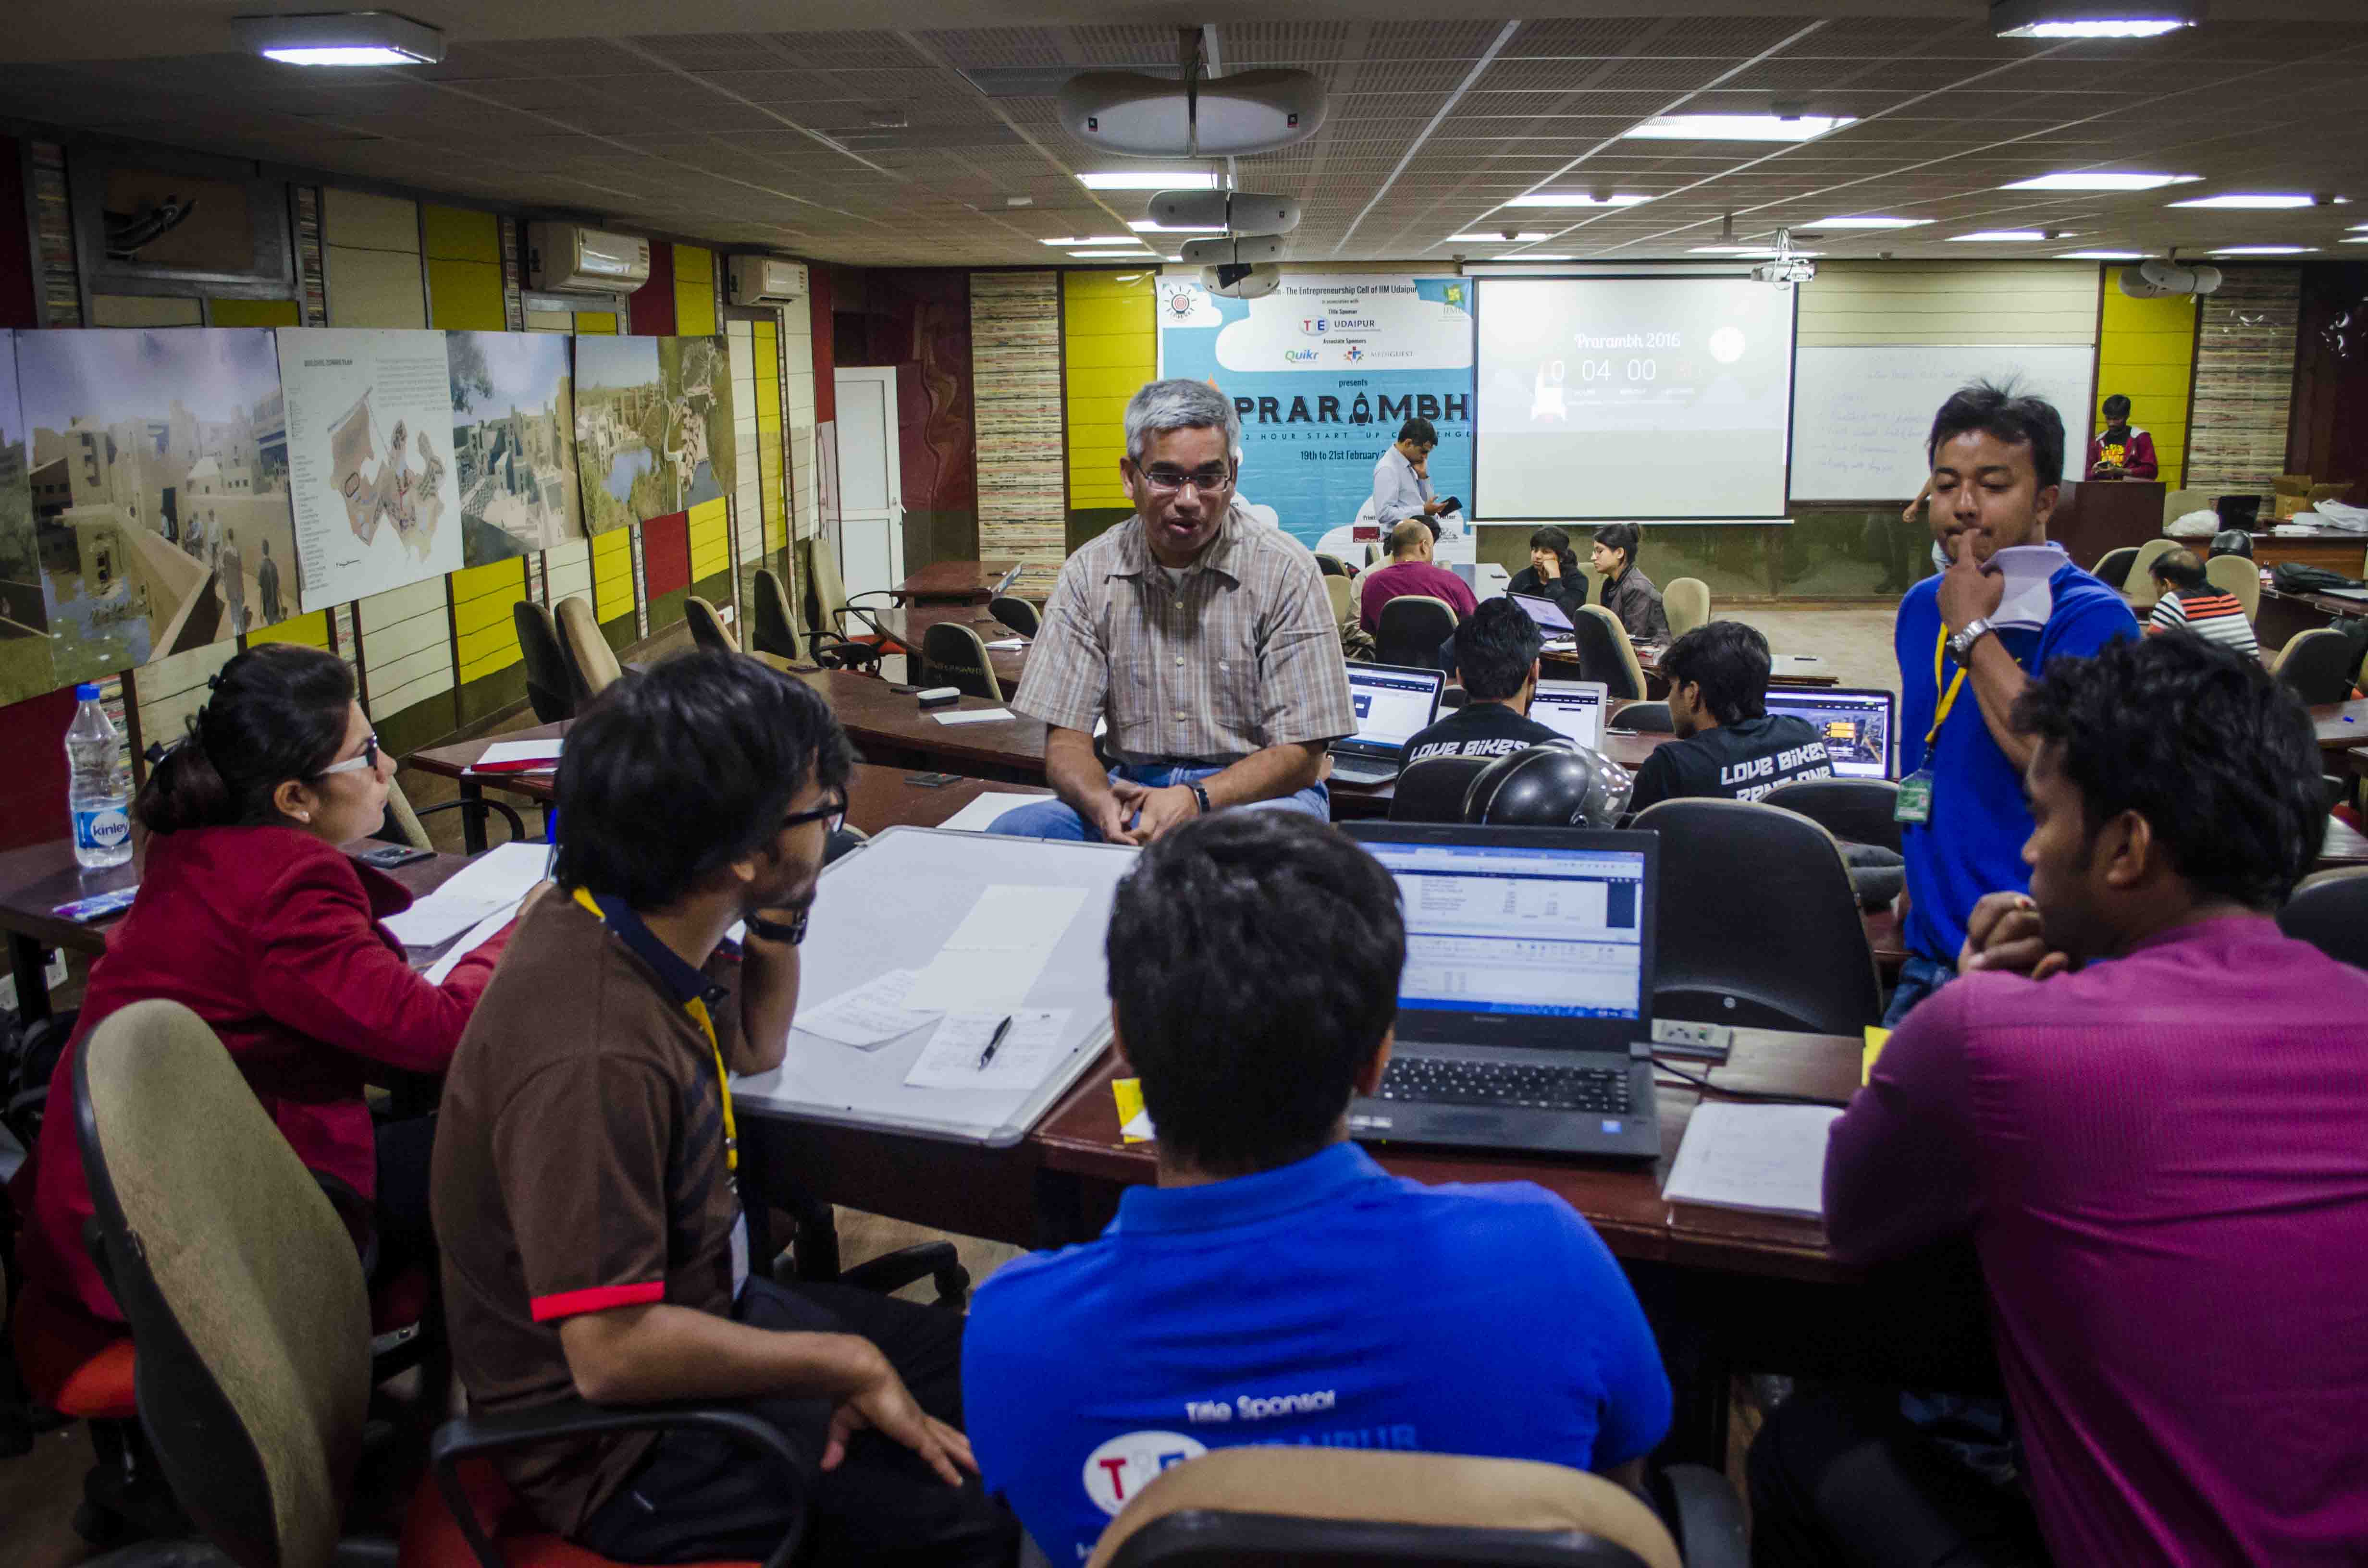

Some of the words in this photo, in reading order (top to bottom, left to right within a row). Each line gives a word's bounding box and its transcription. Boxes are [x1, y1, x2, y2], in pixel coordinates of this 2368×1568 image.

[1286, 287, 1297, 295] The
[1299, 285, 1355, 295] Entrepreneurship
[1357, 285, 1369, 294] Cell
[1371, 285, 1377, 294] of
[1379, 285, 1389, 294] IIM
[1391, 284, 1417, 294] Udaipur
[1646, 332, 1681, 348] 2016
[1285, 349, 1319, 363] Quikr
[1582, 359, 1611, 381] 04
[1627, 358, 1656, 380] 00
[1339, 379, 1368, 388] presents
[1300, 451, 1317, 460] 19th
[1320, 451, 1326, 460] to
[1329, 451, 1344, 460] 21st
[1346, 450, 1379, 461] February
[1184, 1399, 1233, 1424] Title
[1236, 1388, 1336, 1422] Sponsor
